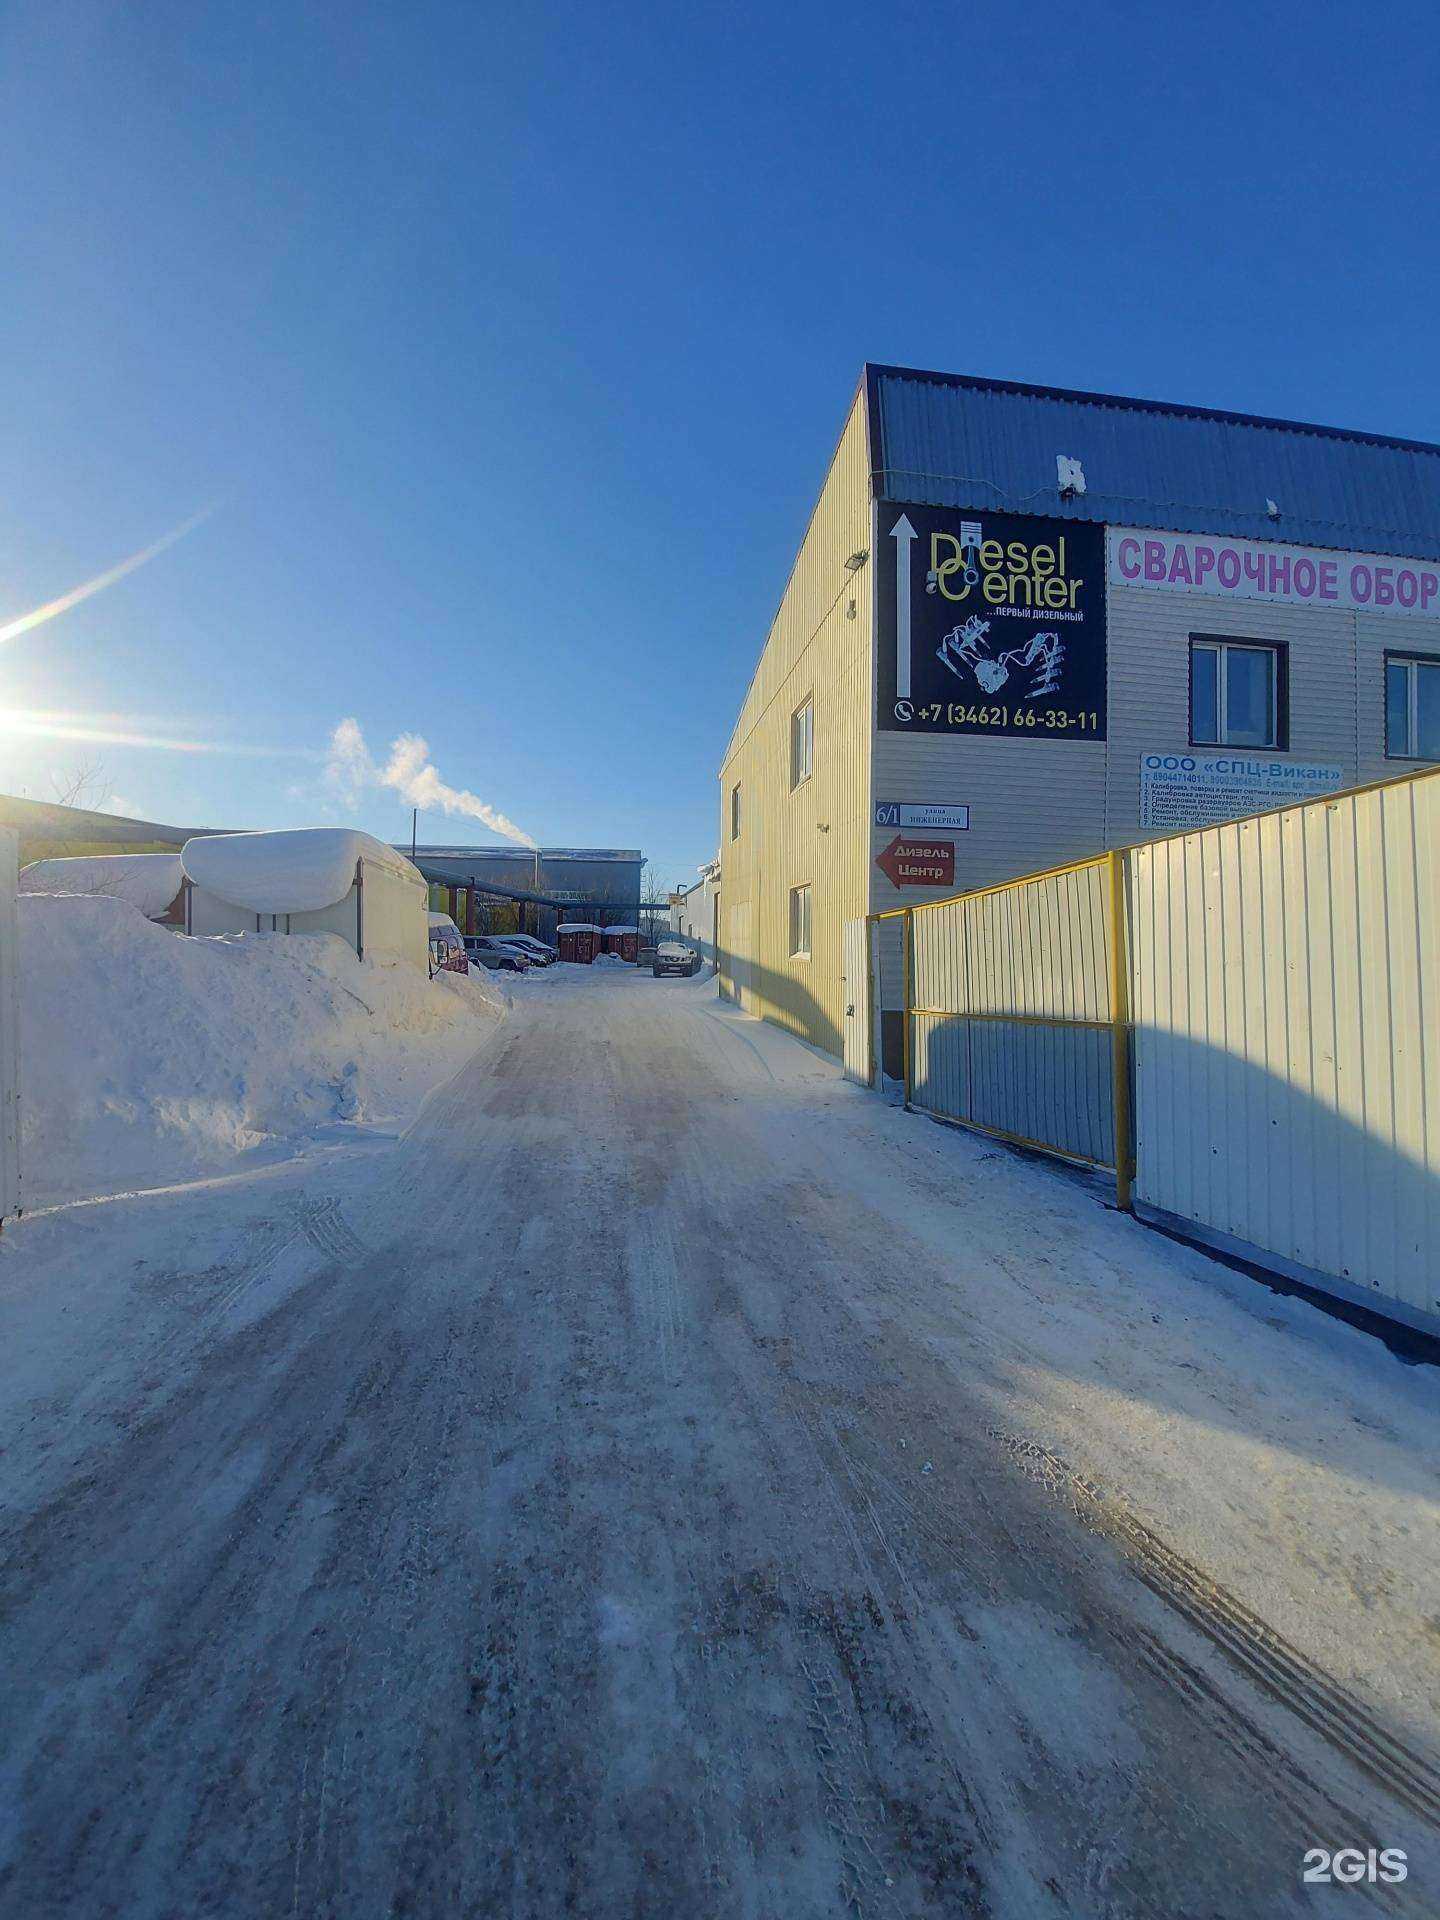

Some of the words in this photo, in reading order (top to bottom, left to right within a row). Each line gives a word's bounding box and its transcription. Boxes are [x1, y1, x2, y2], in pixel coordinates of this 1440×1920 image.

[931, 523, 1065, 577] Diesel
[938, 558, 1084, 609] Center
[1118, 537, 1339, 600] СВАРОЧНОЕ
[1350, 564, 1439, 610] ОБОР
[1032, 609, 1084, 622] ДИЗЕЛЬНЫЙ
[917, 703, 942, 722] +7
[947, 703, 1008, 727] (3462)
[1013, 708, 1097, 730] 66-33-11
[1145, 755, 1196, 772] ООО
[1203, 760, 1340, 781] «СПЦ-Викан»
[875, 805, 899, 825] 6/1
[894, 845, 949, 858] Дизель
[898, 864, 944, 879] Центр
